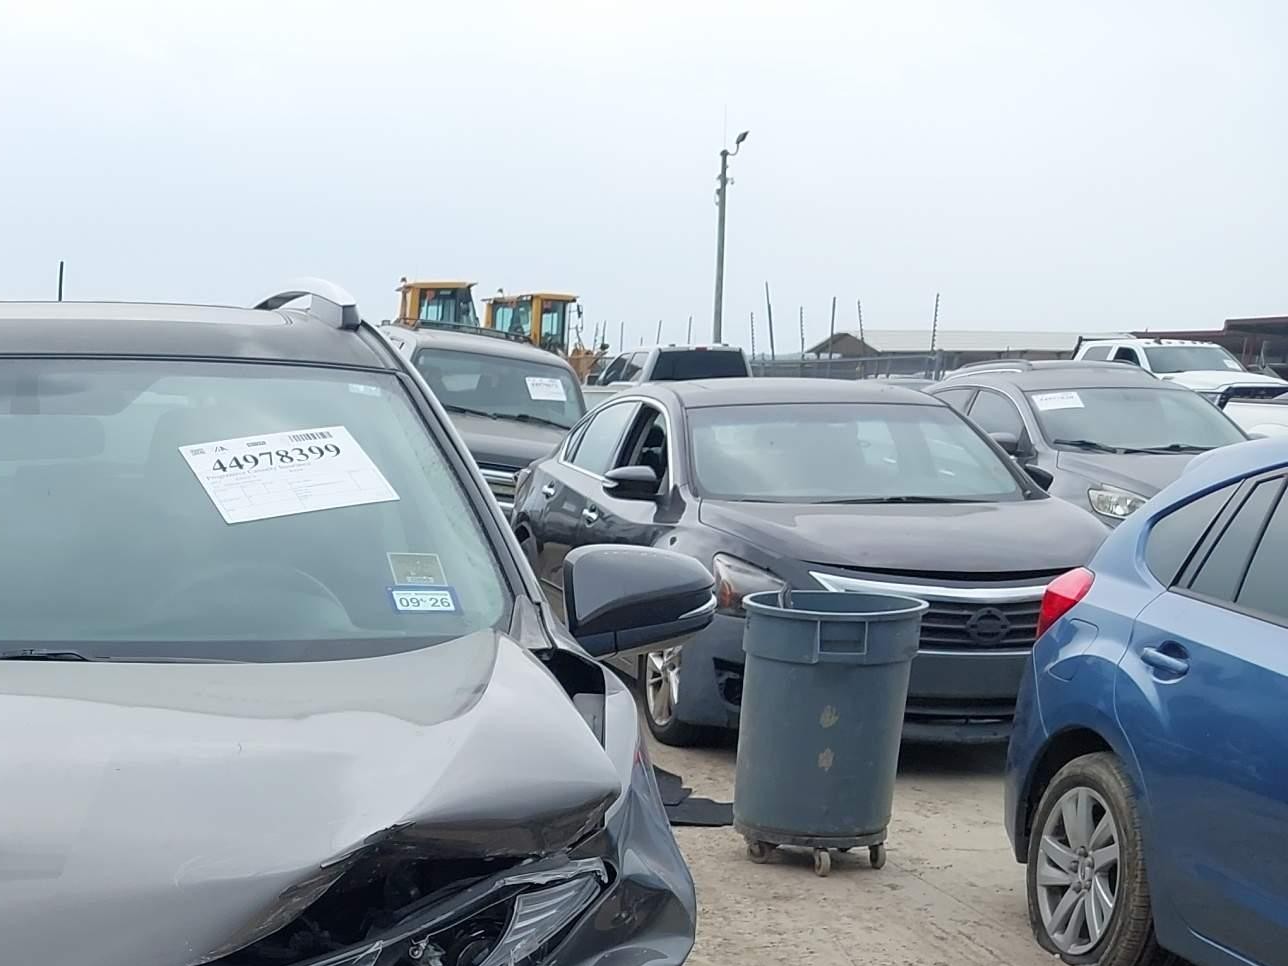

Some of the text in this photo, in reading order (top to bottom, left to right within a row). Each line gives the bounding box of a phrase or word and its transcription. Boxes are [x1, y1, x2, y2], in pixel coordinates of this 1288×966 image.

[212, 443, 341, 473] 44978399
[399, 597, 451, 608] 09 26
